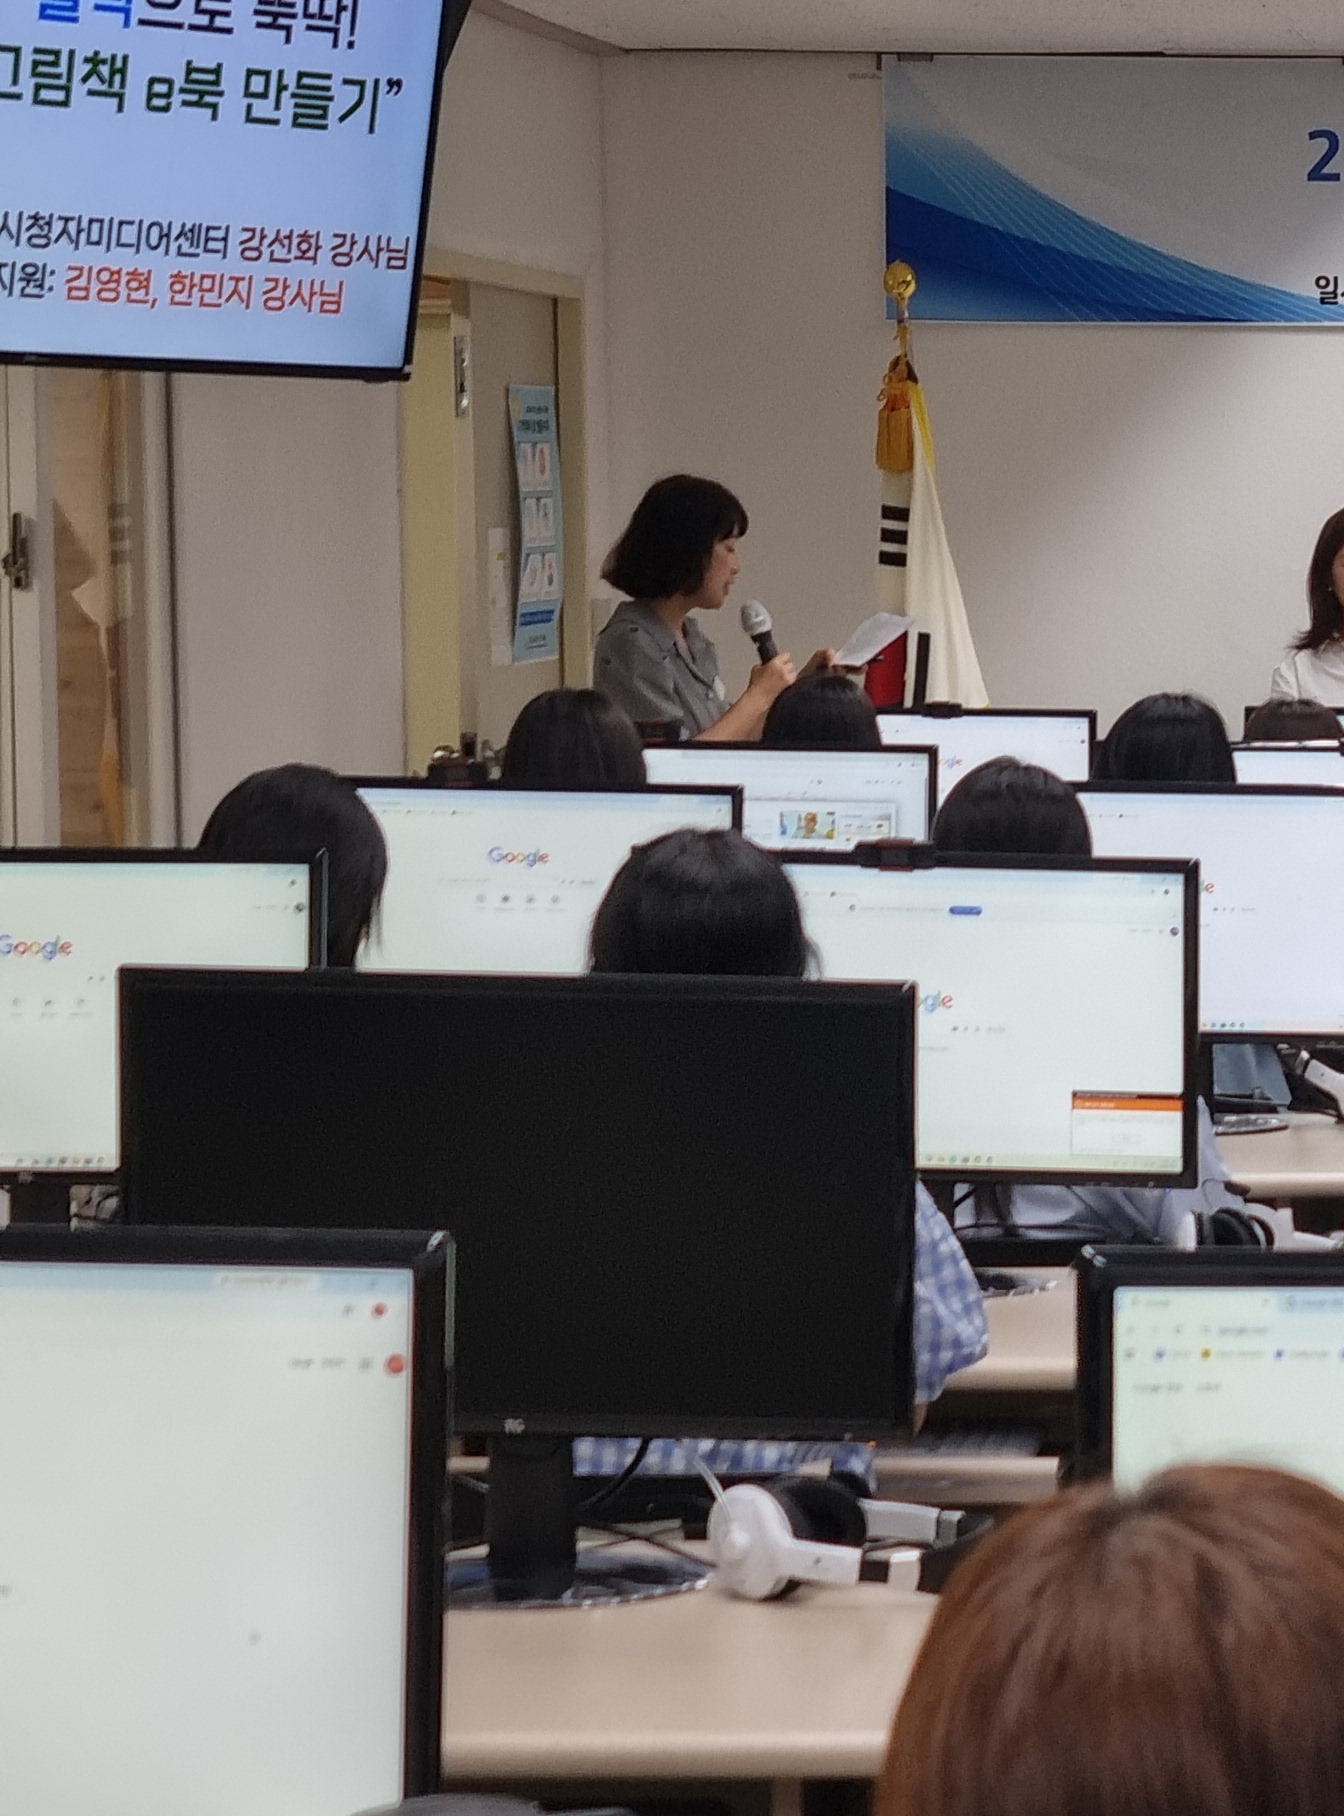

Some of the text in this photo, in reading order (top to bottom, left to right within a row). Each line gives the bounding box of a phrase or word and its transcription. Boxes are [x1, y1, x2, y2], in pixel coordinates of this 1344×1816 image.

[38, 0, 235, 35] 으로
[0, 44, 130, 114] 그림책
[145, 59, 225, 122] e북
[0, 210, 410, 271] 시청자미디어센터 강선화 강사님
[65, 265, 158, 310] 김영현,
[169, 270, 253, 310] 한민지
[261, 276, 344, 315] 강사님
[487, 846, 549, 867] Google
